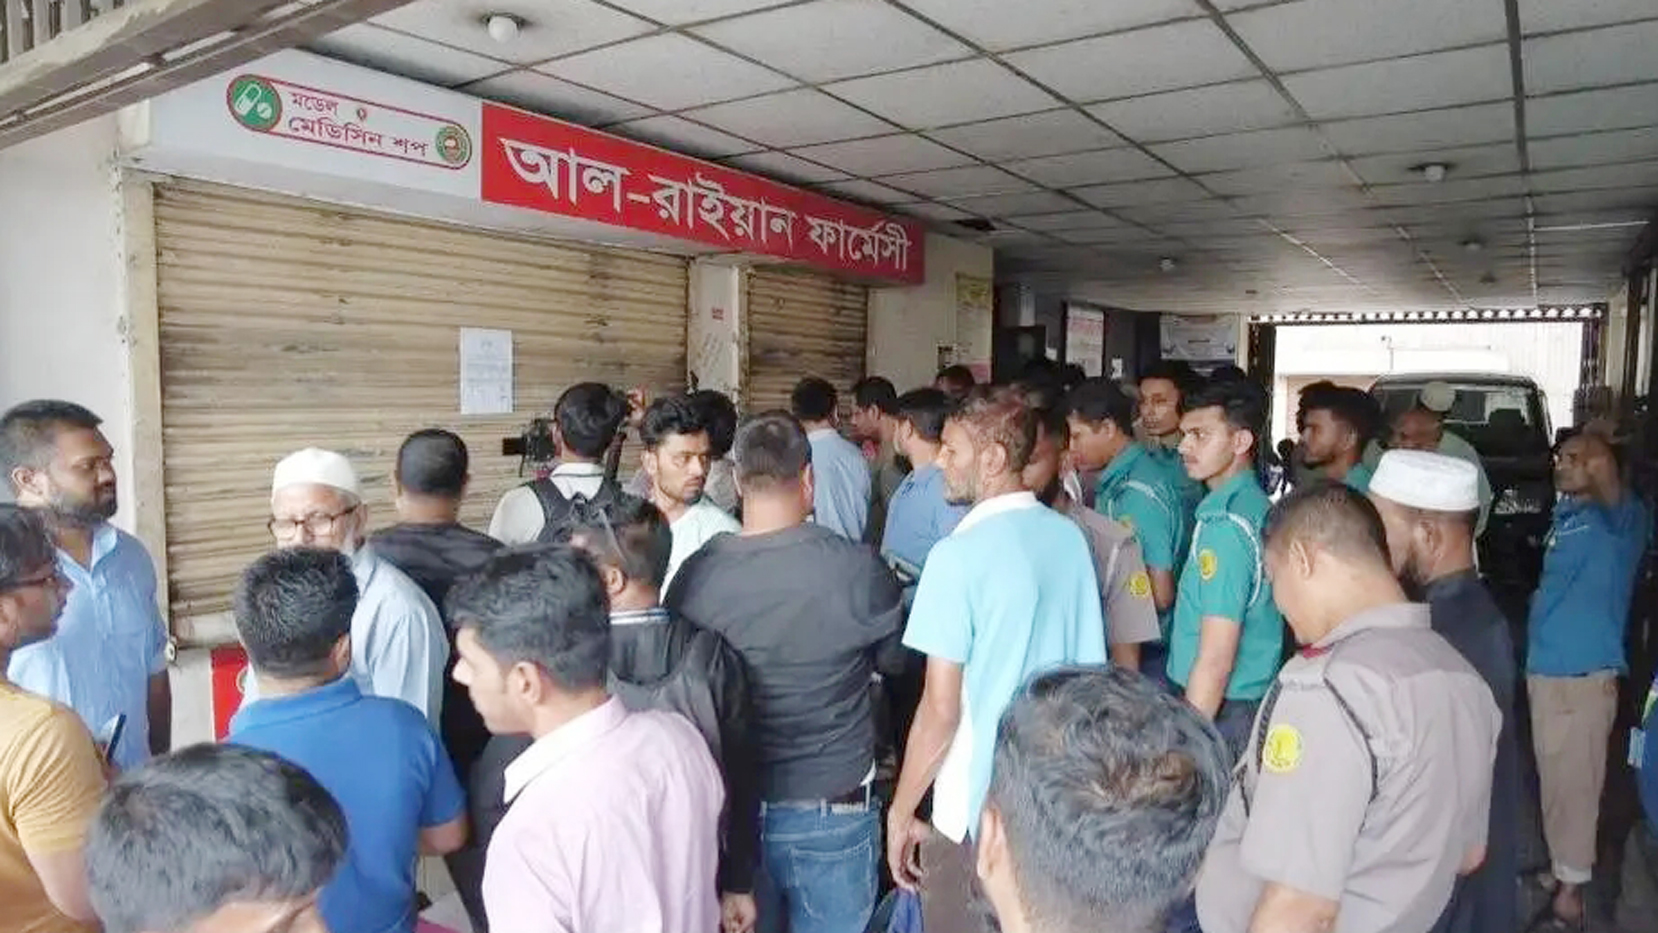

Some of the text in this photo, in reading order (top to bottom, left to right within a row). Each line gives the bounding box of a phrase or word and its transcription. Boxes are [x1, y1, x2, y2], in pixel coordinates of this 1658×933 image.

[290, 92, 339, 116] মডেল
[289, 116, 382, 146] মেডিসিন
[393, 136, 428, 156] শপ
[807, 214, 912, 271] ফার্মেসী
